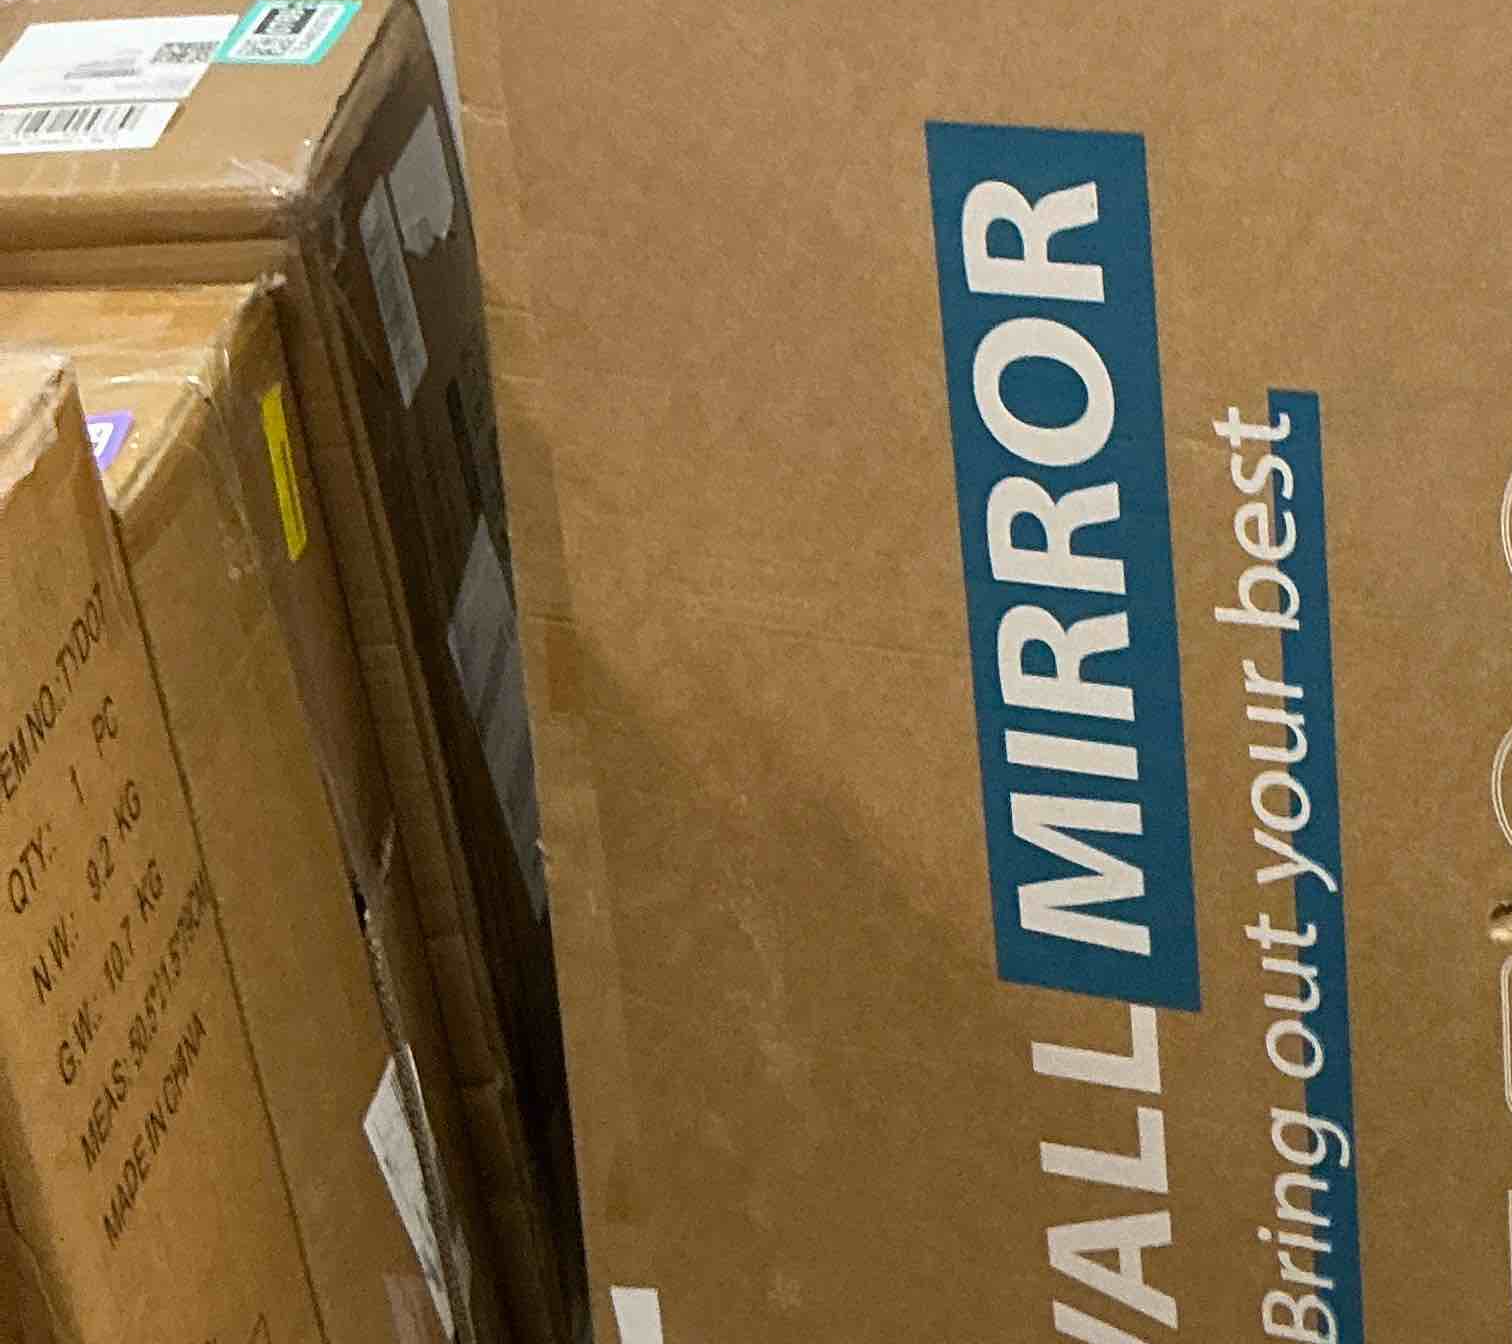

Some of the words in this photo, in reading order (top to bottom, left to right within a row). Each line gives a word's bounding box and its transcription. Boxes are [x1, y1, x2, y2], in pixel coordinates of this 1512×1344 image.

[961, 180, 1151, 957] MIRROR
[1213, 406, 1300, 631] best
[1238, 659, 1338, 894] your
[1246, 912, 1324, 1080] out
